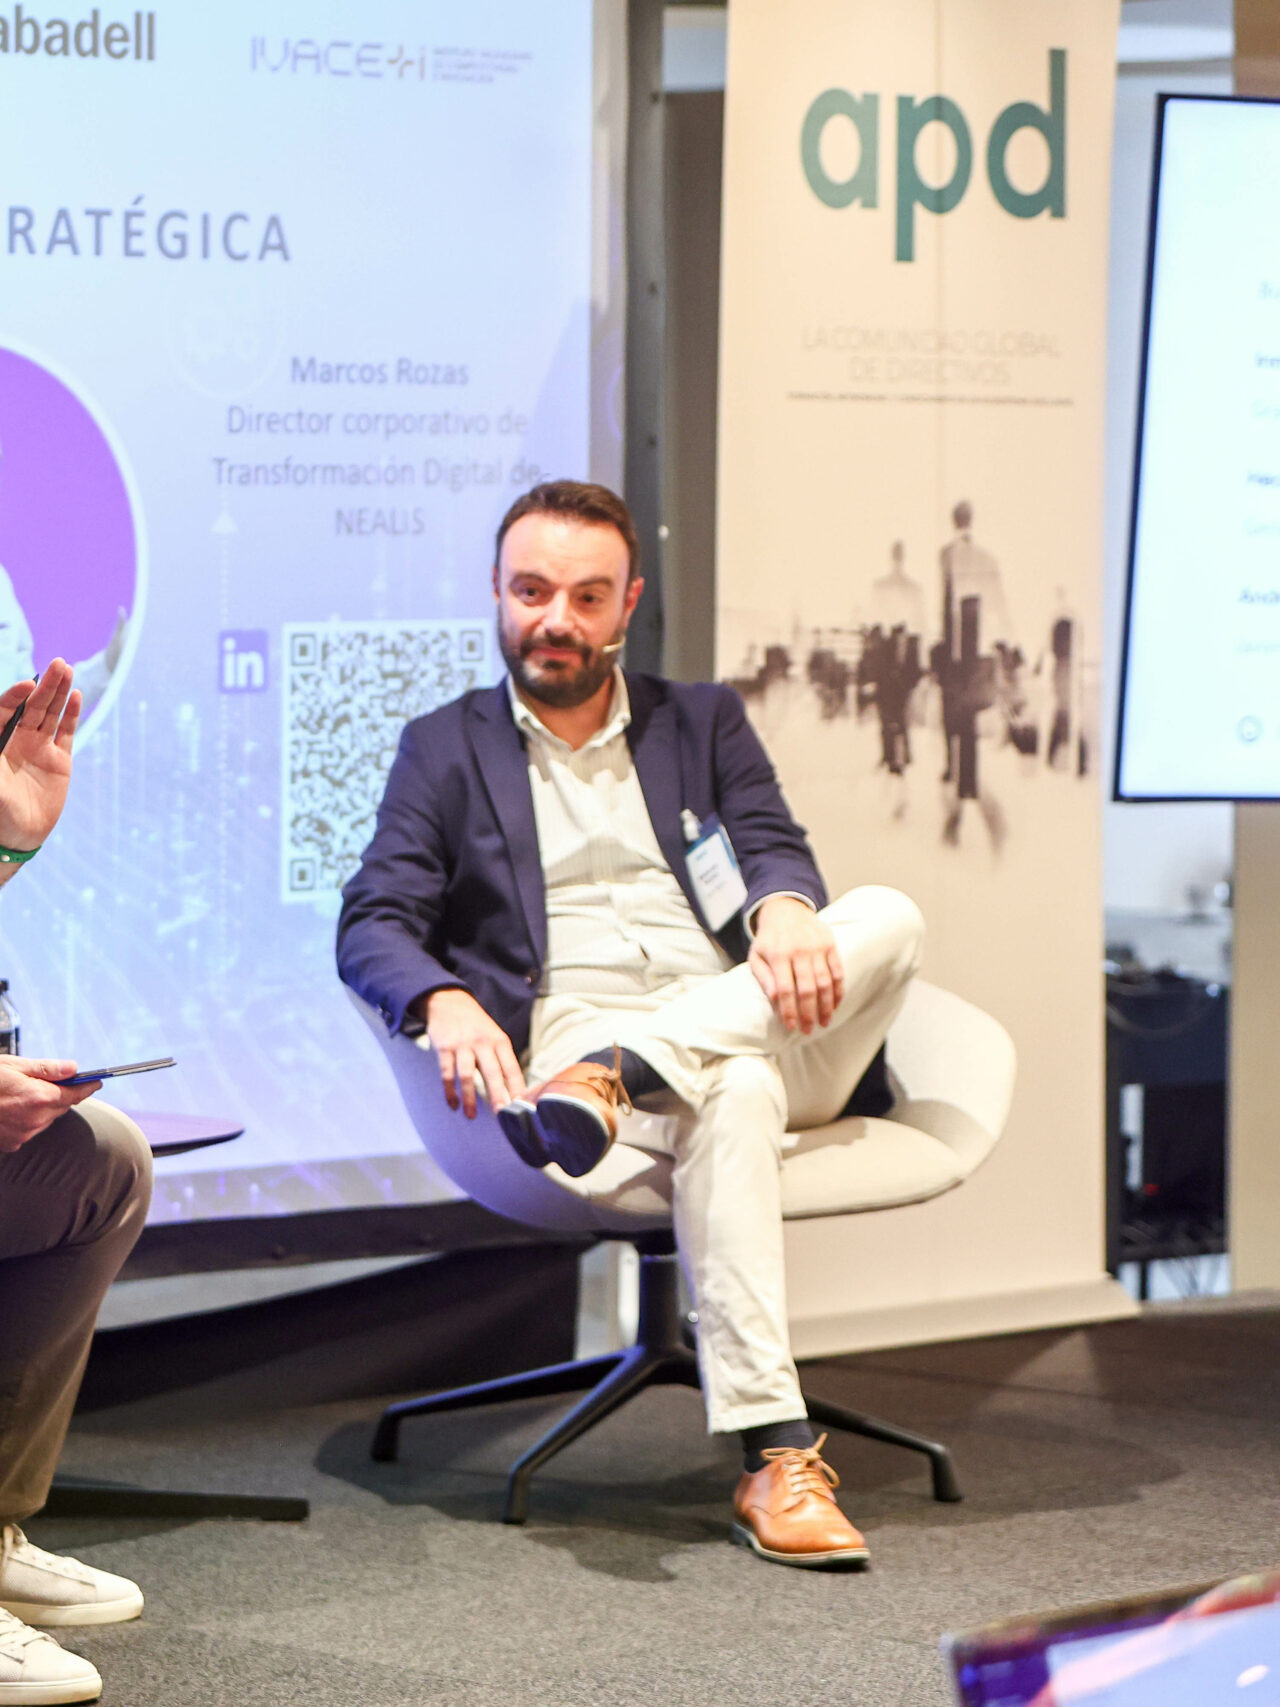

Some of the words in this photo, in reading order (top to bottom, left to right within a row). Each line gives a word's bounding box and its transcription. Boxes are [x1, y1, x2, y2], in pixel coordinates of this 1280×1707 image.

[800, 48, 1069, 262] apd
[291, 357, 388, 385] Marcos
[395, 358, 470, 386] Rozas
[228, 406, 333, 434] Director
[342, 410, 490, 438] corporativo
[497, 410, 527, 435] de
[213, 457, 415, 486] Transformación
[424, 457, 504, 492] Digital
[509, 459, 541, 485] de
[223, 637, 264, 688] in
